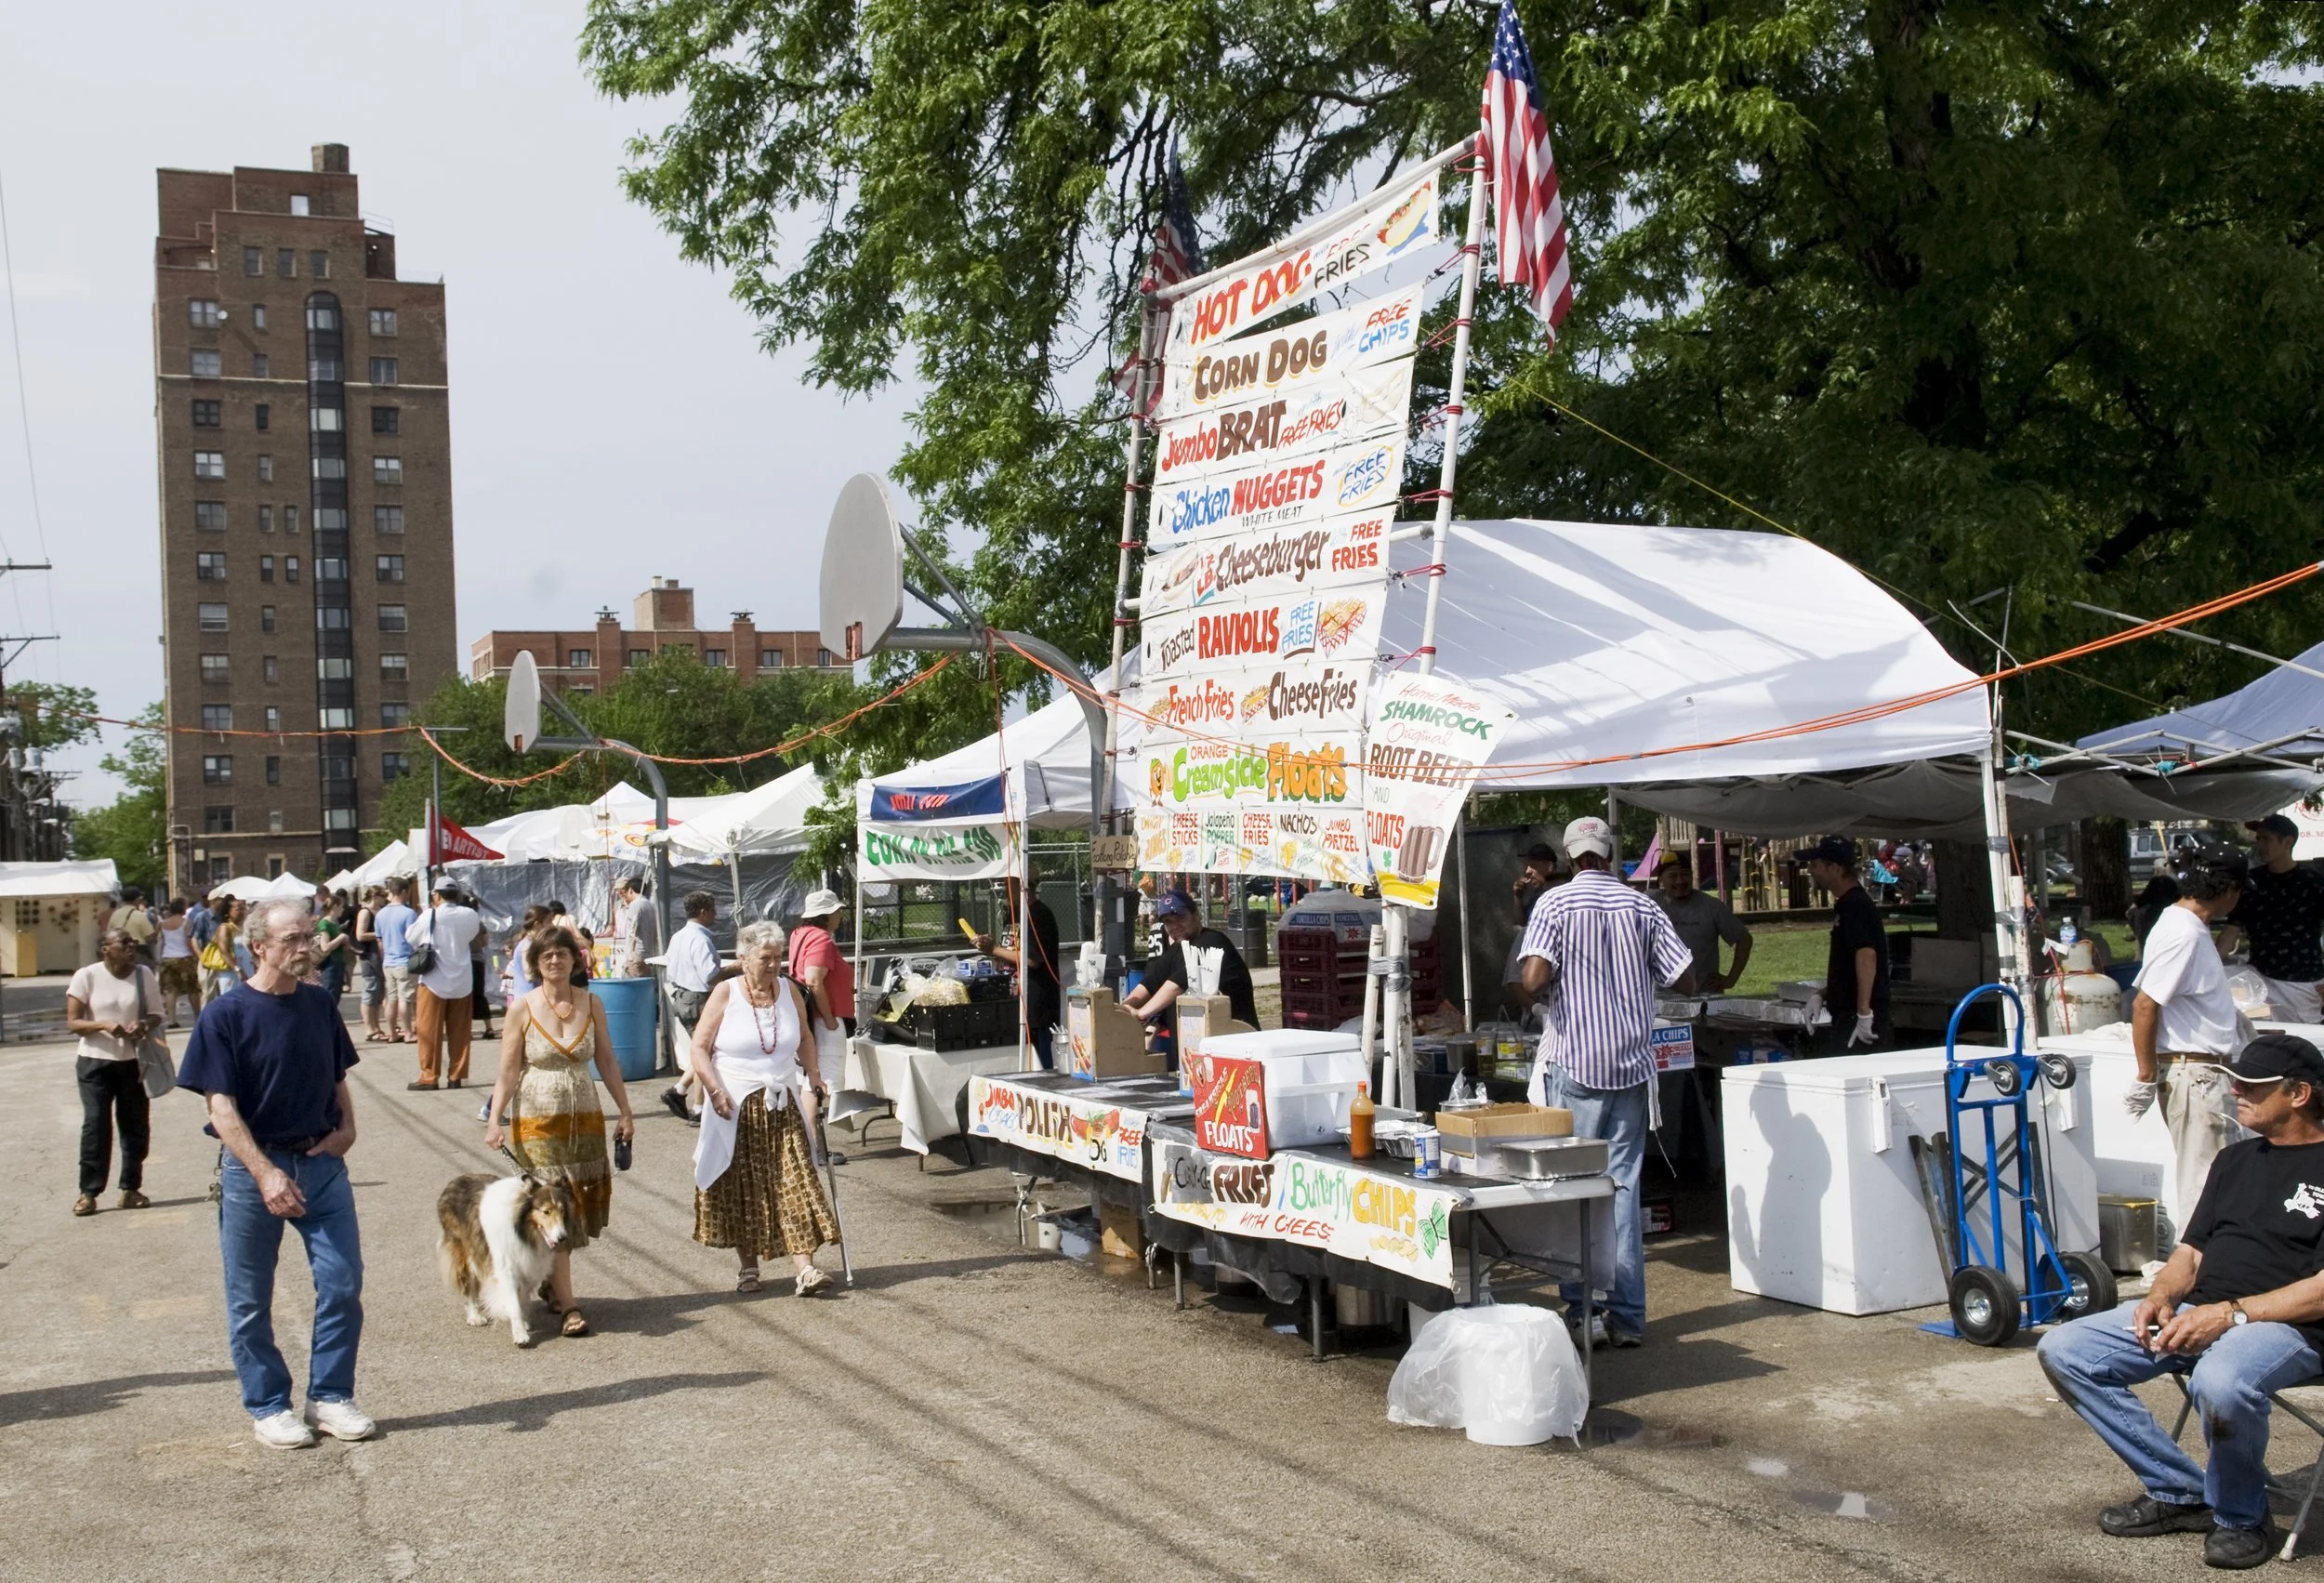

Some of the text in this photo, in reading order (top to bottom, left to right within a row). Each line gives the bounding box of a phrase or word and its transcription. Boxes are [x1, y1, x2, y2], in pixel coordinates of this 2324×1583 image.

[1191, 278, 1248, 346] HOT
[1314, 244, 1370, 290] FRIES
[1366, 298, 1411, 330] FREE
[1194, 319, 1410, 403] CORN DOG CHIPS
[1161, 398, 1344, 472] Jumbo BRAT FREE FRIES
[1344, 446, 1386, 484] FREE
[1172, 459, 1386, 534] Chicken NUGGETS FRIES
[1242, 505, 1304, 527] WHITE MEAT
[1350, 519, 1383, 542] FREE
[1216, 530, 1331, 592] Cheeseburger
[1332, 542, 1379, 572] FRIES
[1290, 600, 1314, 627] FREE
[1160, 606, 1314, 671] Toasted RAVIOLIS FRIES
[1168, 668, 1357, 725] French Fries Cheese Fries
[1399, 682, 1438, 703] Home
[1380, 700, 1494, 741] SHAMROCK
[1386, 721, 1454, 747] Original
[1190, 745, 1229, 760] ORANGE
[1368, 743, 1474, 790] ROOT BEER
[1173, 742, 1348, 803] Creamsicle Floats
[1373, 785, 1390, 804] AND
[1172, 812, 1198, 828] CHEESE
[1243, 812, 1273, 829] CHEESE
[1326, 818, 1351, 833] JUMBO
[1172, 830, 1198, 846] STICKS
[1207, 829, 1235, 845] POPPER
[1243, 830, 1269, 846] FRIES
[1322, 833, 1360, 852] PRETZEL
[1367, 811, 1405, 850] FLOATS
[1662, 1027, 1688, 1041] CHIPS
[1204, 1120, 1254, 1153] FLOATS
[1213, 1164, 1274, 1208] FRIES
[1353, 1177, 1418, 1238] CHIPS
